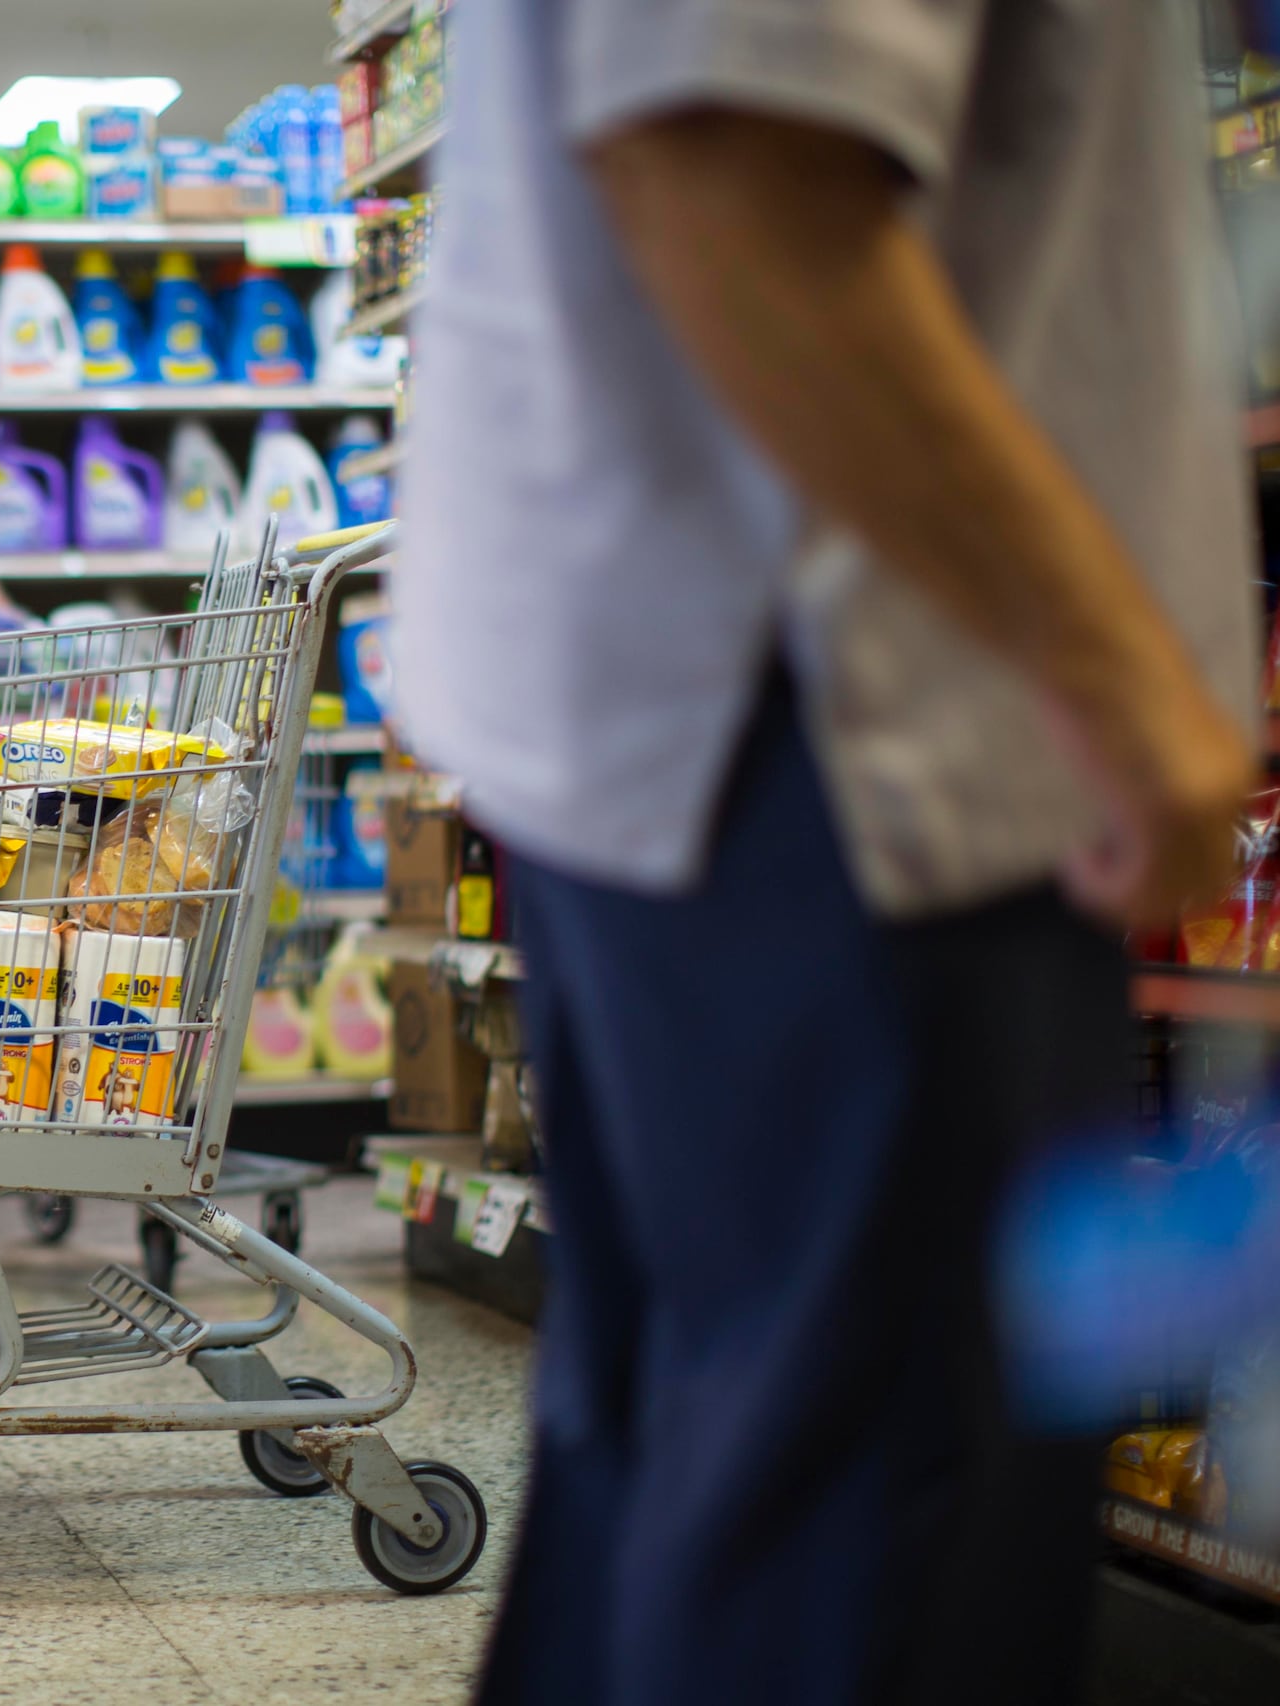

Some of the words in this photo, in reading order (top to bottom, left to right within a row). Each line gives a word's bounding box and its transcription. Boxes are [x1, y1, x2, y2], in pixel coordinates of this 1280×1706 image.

[6, 742, 64, 762] OREO
[1113, 1505, 1156, 1541] GROW
[1159, 1521, 1185, 1554] THE
[1188, 1532, 1222, 1569] BEST
